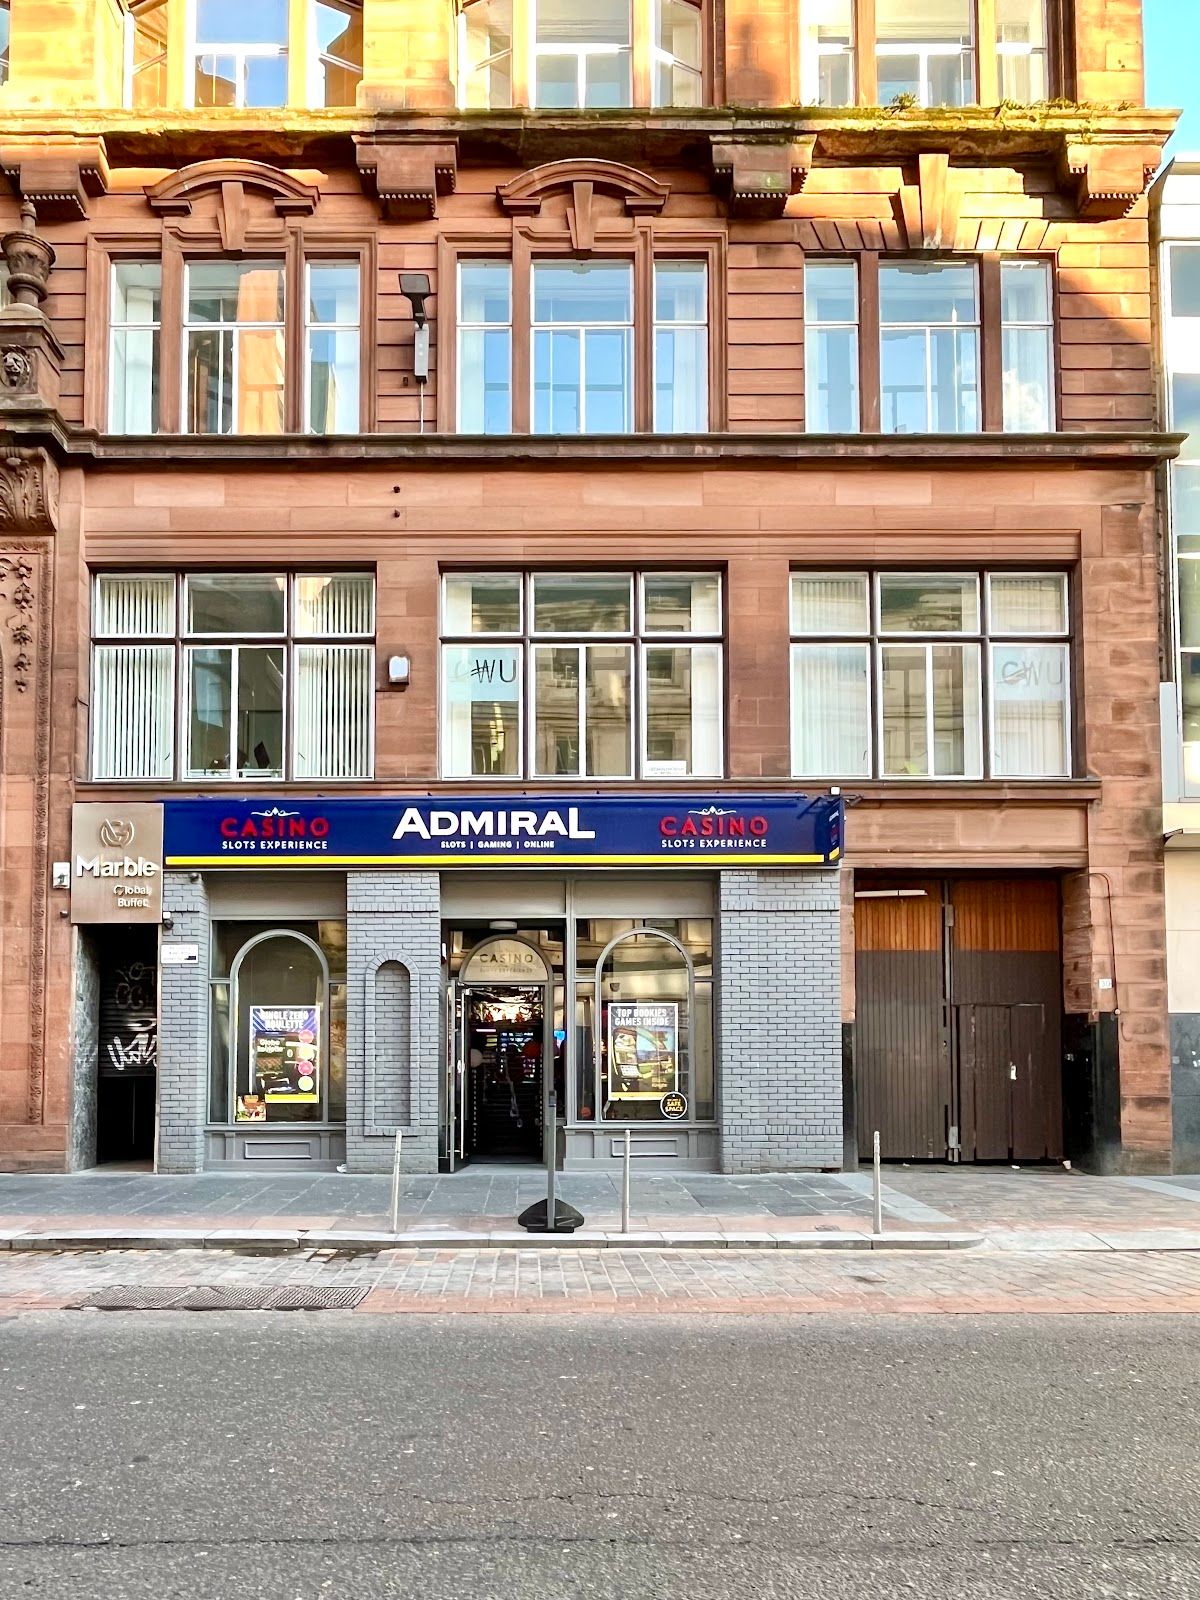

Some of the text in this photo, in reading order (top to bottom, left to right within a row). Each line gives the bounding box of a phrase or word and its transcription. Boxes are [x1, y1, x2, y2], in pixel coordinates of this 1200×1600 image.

[1002, 661, 1063, 686] CWU
[221, 817, 329, 837] CASINO
[392, 807, 596, 839] ADMIRAL
[661, 816, 768, 836] CASINO
[222, 840, 328, 849] SLOTS EXPERIENCE
[662, 839, 767, 848] SLOTS EXPERIENCE
[76, 854, 158, 877] Marble
[480, 953, 533, 963] CASINO
[289, 1010, 309, 1020] ZERO
[617, 1008, 667, 1017] TOP BOOKIES
[615, 1017, 670, 1026] GAMES INSIDE
